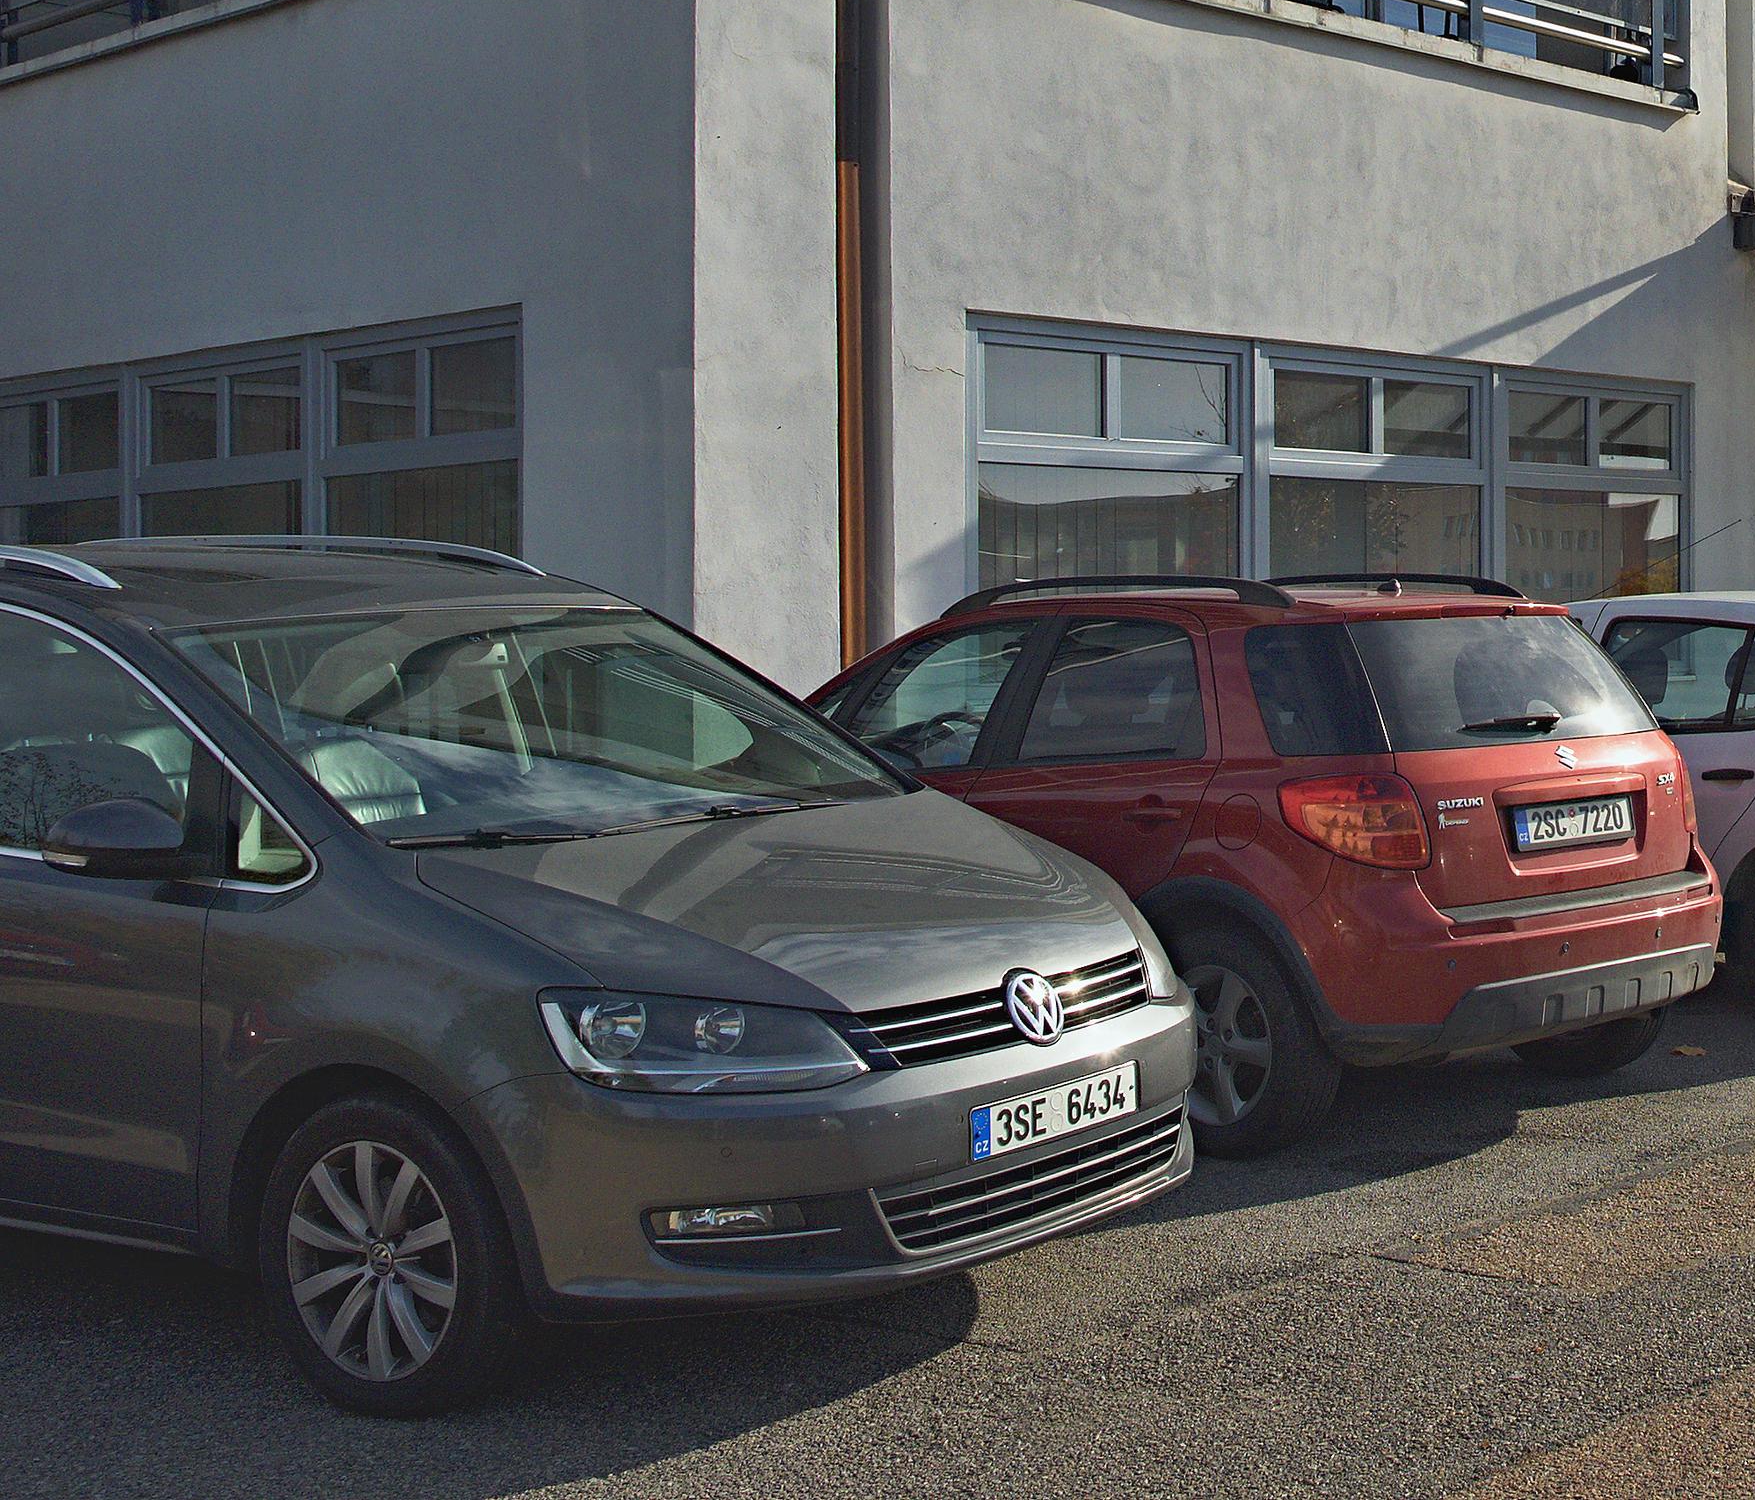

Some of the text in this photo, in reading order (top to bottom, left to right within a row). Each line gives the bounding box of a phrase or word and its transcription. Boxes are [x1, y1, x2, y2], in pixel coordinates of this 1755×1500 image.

[1437, 796, 1484, 810] SUZUKI
[1518, 802, 1624, 842] CZ 2SC 7220
[975, 1074, 1126, 1153] CZ 3SE 6434
